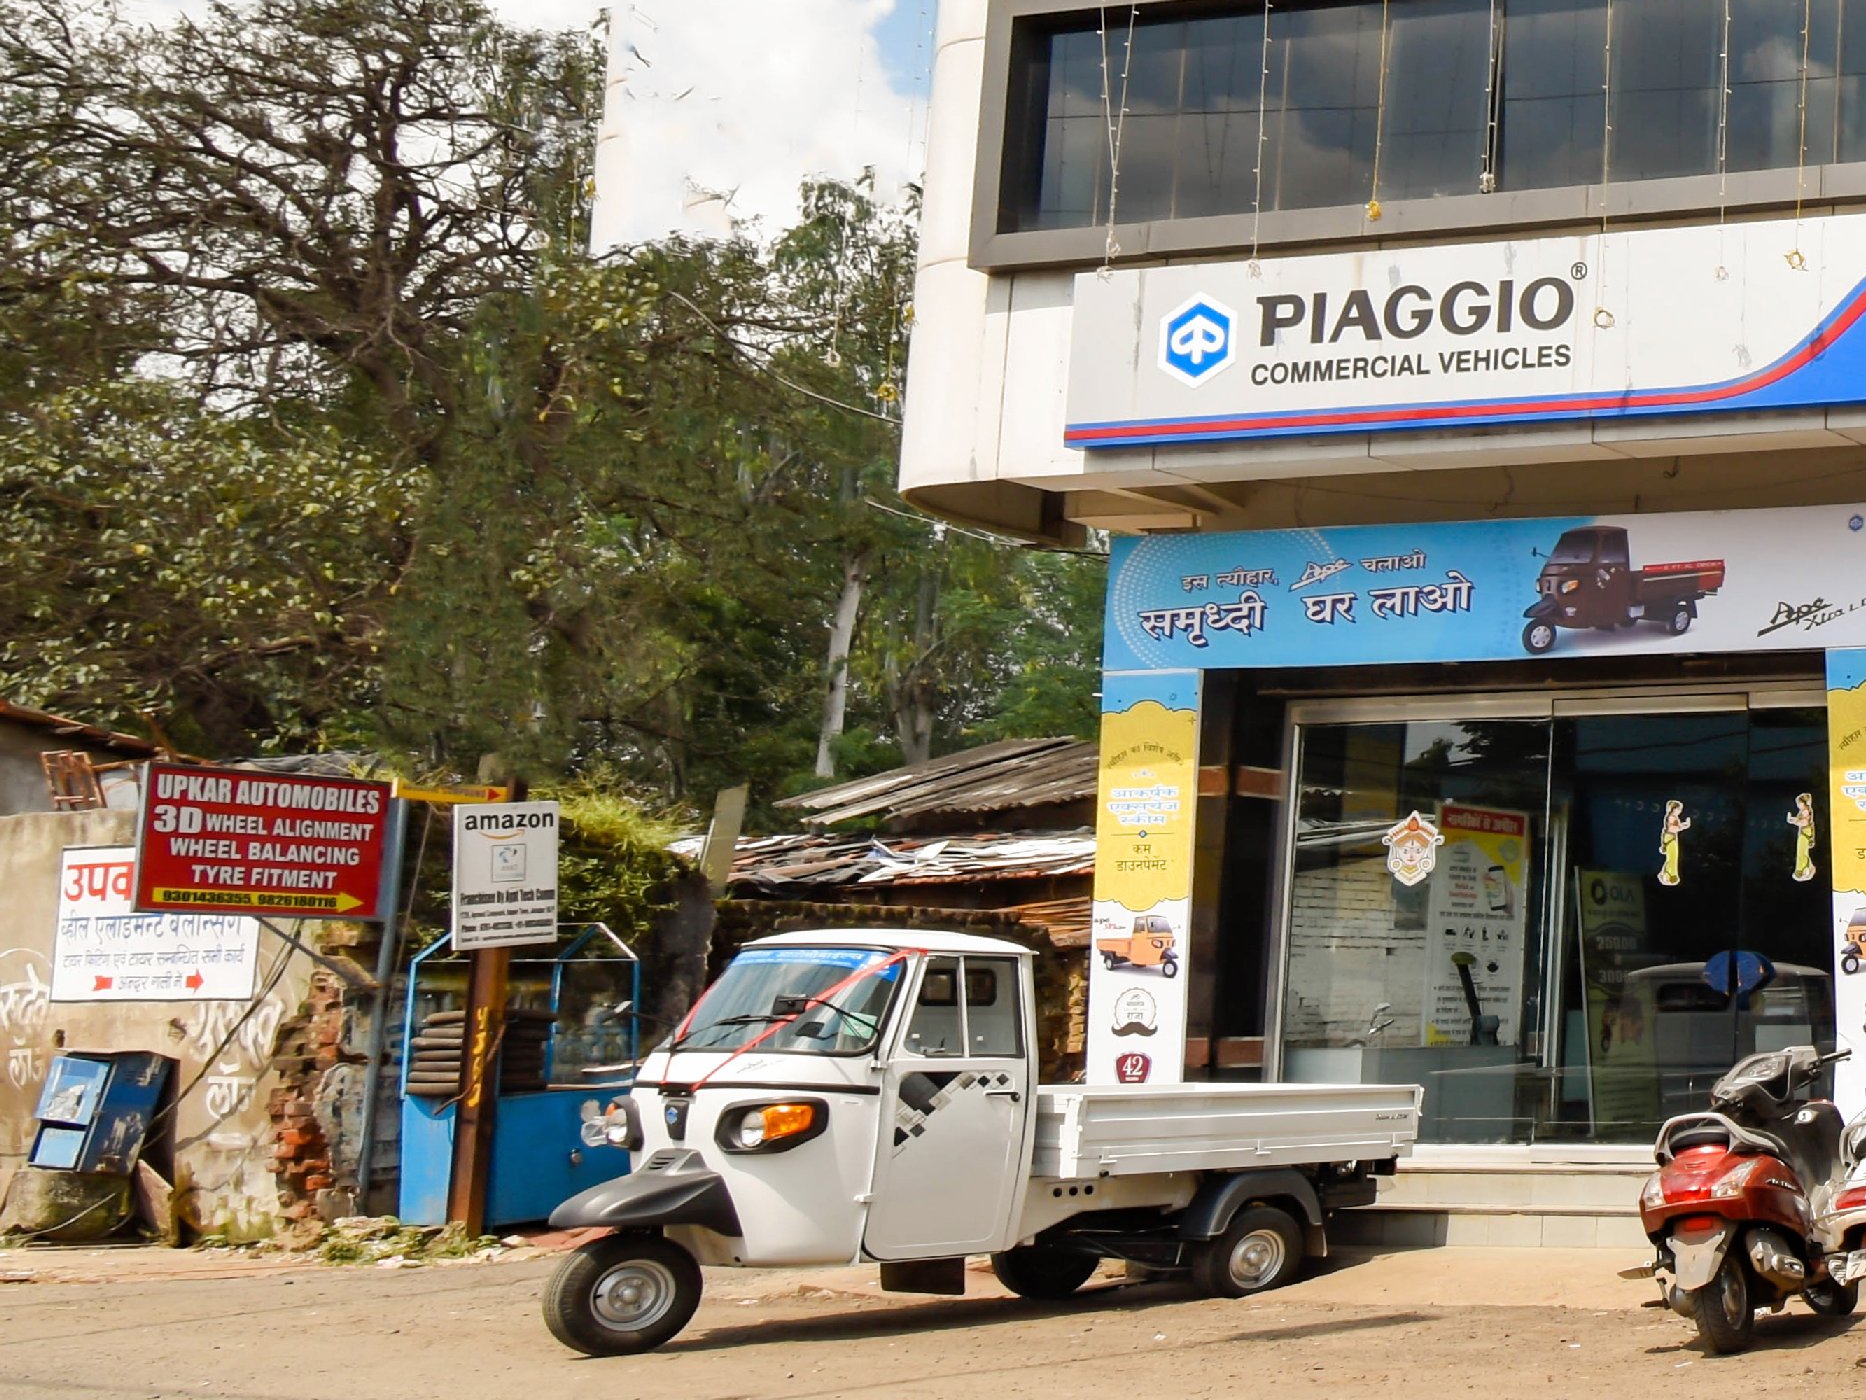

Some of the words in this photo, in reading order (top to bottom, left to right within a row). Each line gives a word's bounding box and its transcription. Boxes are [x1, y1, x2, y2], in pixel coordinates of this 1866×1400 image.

[1250, 353, 1431, 386] COMMERCIAL
[1438, 343, 1571, 375] VEHICLES
[1181, 575, 1209, 594] इस
[1360, 548, 1426, 573] चलाओ
[1301, 592, 1357, 627] घर
[1369, 570, 1475, 620] लाओ
[156, 773, 232, 804] UPKAR
[236, 780, 381, 815] AUTOMOBILES
[153, 804, 204, 834] 3D
[206, 813, 268, 836] WHEEL
[272, 818, 375, 842] ALIGNMENT
[465, 812, 554, 830] amazon
[170, 837, 242, 860] WHEEL
[248, 842, 361, 866] BALANCING
[192, 865, 246, 886] TYRE
[251, 868, 338, 890] FITMENT
[1122, 1055, 1144, 1076] 42
